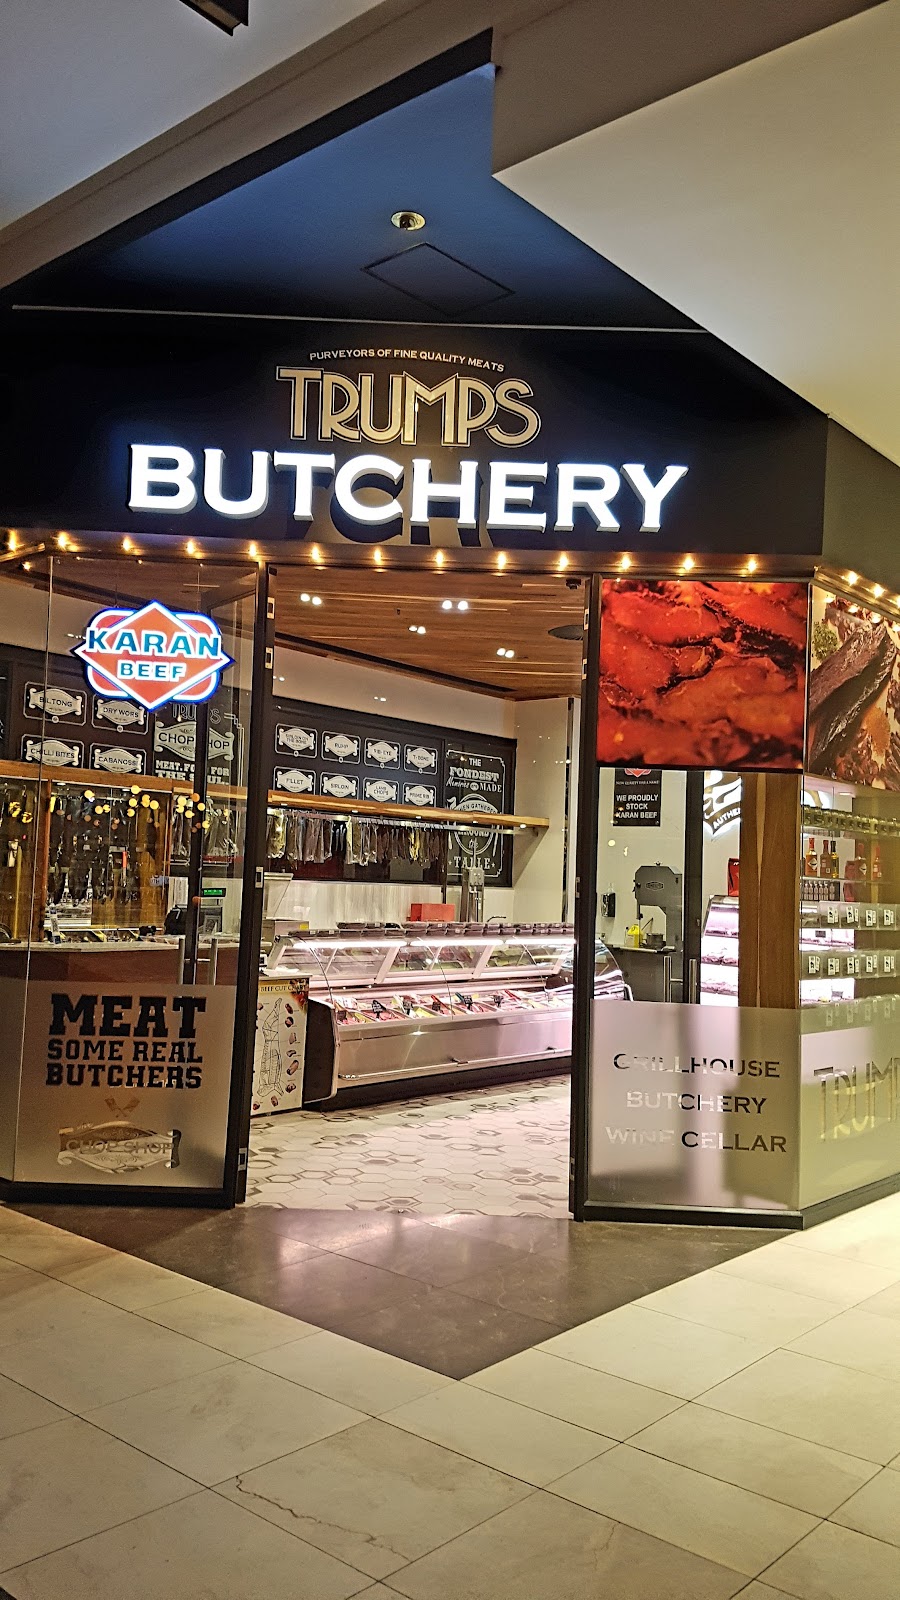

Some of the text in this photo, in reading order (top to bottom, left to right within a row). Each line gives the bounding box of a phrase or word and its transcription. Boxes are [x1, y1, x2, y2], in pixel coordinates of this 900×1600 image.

[309, 349, 505, 373] PURVEYORS OF FINE QUALITY MEATS
[276, 366, 542, 448] TRUMPS
[128, 443, 689, 533] BUTCHERY
[87, 629, 220, 658] KARAN
[119, 661, 186, 680] BEEF
[39, 696, 73, 708] BLTONG
[158, 732, 195, 745] CHOP
[31, 748, 54, 756] CHLLI
[468, 757, 482, 767] THE
[449, 766, 500, 782] FONDEST
[480, 782, 503, 793] MADE
[616, 793, 659, 802] WE PROUDLY
[640, 811, 658, 819] BEEF
[48, 993, 207, 1039] MEAT
[48, 1039, 203, 1064] SOME REAL
[46, 1062, 203, 1090] BUTCHERS
[613, 1053, 780, 1078] GRILLHOUSE
[626, 1091, 767, 1114] BUTCHERY
[605, 1126, 787, 1153] WINE CELLAR
